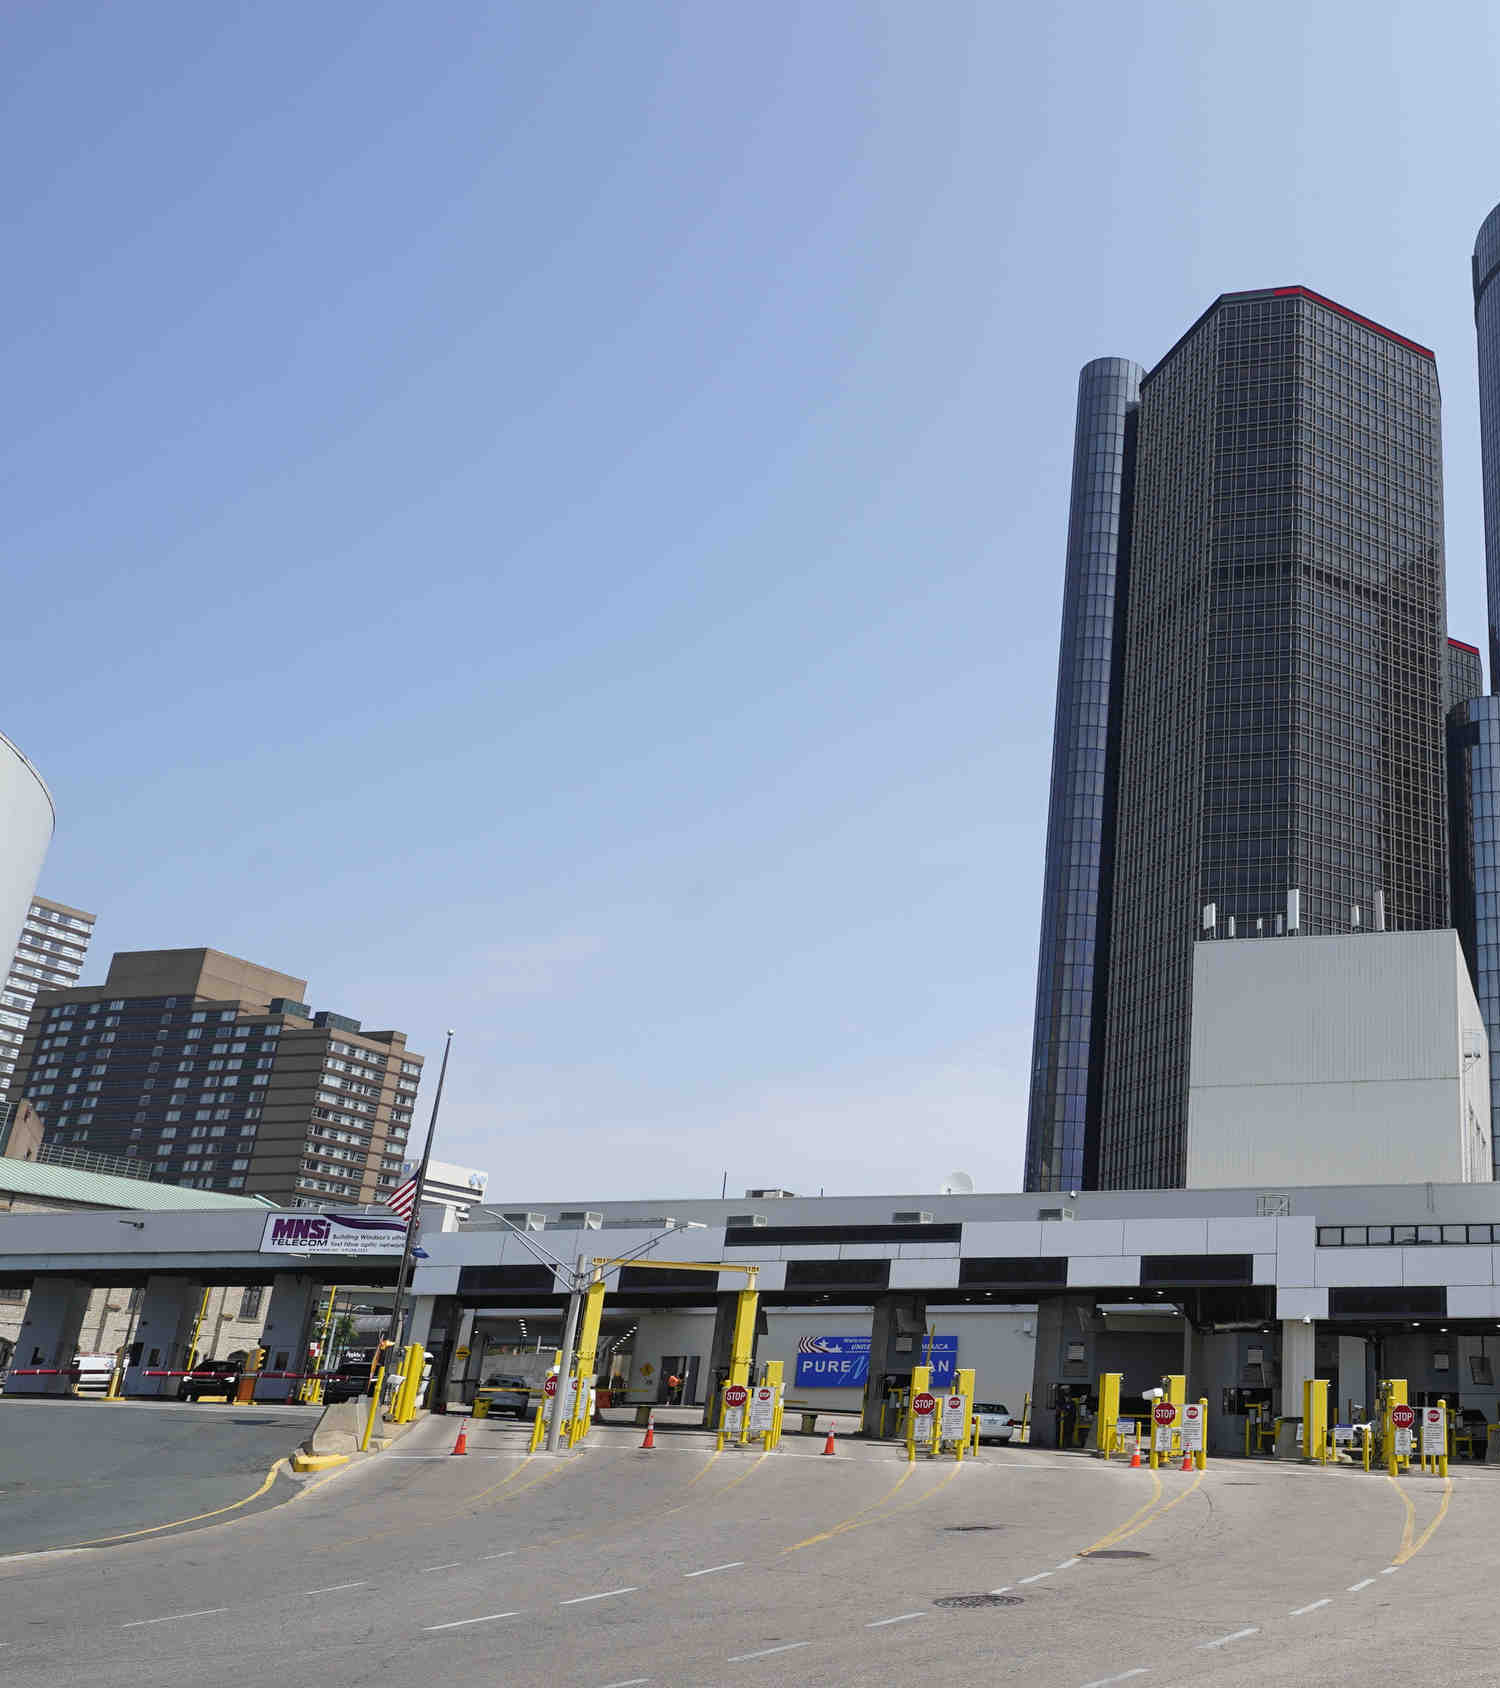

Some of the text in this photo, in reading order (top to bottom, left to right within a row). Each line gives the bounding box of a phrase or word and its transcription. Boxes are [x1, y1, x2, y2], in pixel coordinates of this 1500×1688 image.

[272, 1218, 331, 1239] MNSi
[333, 1233, 359, 1241] Building
[272, 1239, 328, 1247] TELECOM
[802, 1360, 851, 1373] PURE
[726, 1391, 746, 1401] STOP
[914, 1399, 934, 1409] STOP
[1155, 1408, 1175, 1419] STOP
[1393, 1411, 1413, 1421] STOP
